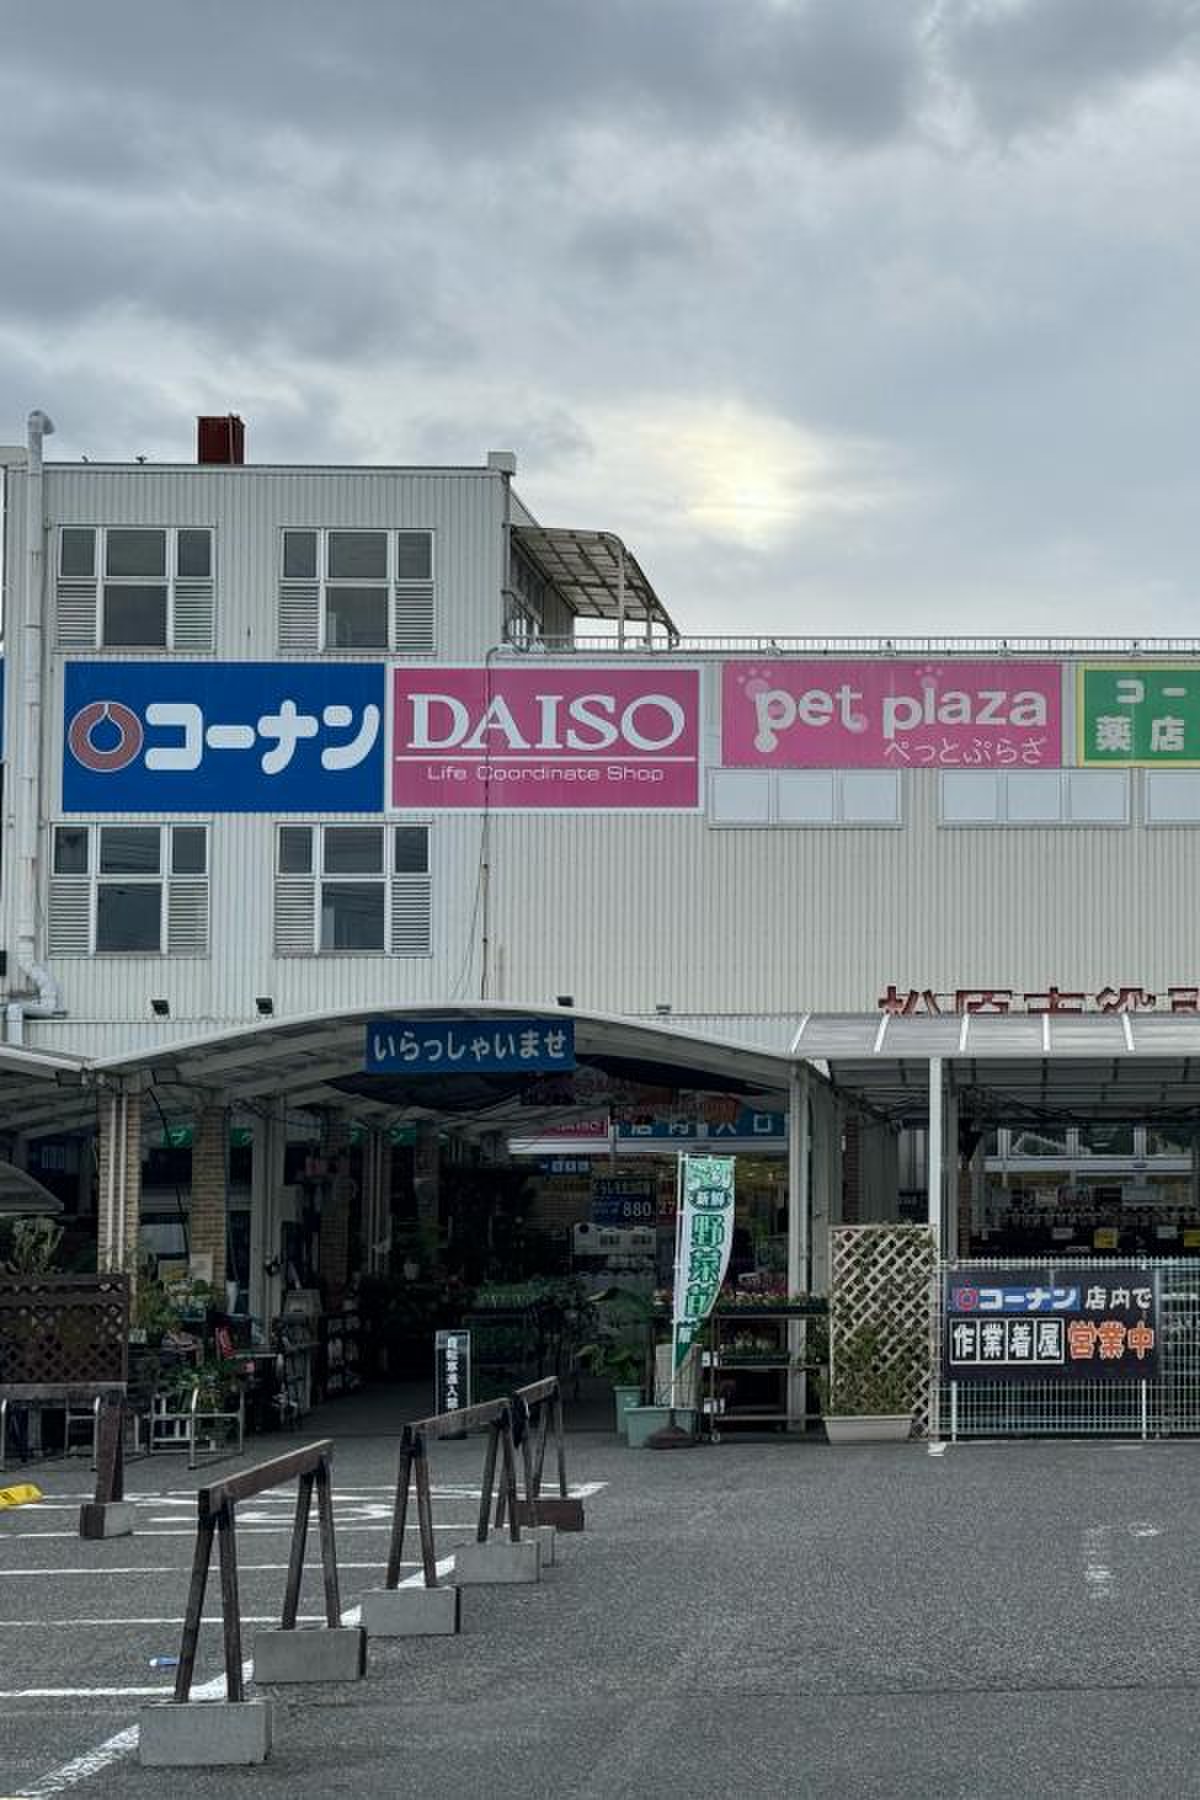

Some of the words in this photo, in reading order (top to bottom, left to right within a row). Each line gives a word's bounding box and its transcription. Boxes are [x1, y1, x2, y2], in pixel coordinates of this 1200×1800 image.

[146, 699, 379, 774] コーナン
[406, 692, 685, 751] DAISO
[754, 685, 868, 753] pet
[882, 684, 1047, 738] plaza
[1096, 716, 1184, 750] 薬店
[427, 764, 467, 782] Life
[478, 764, 601, 782] Coordinate
[609, 764, 665, 785] Shop
[374, 1029, 567, 1062] いらっしゃいませ
[979, 1285, 1077, 1311] コーナン
[1085, 1285, 1154, 1311] 店内で
[953, 1323, 1061, 1360] 作業着屋
[1067, 1320, 1155, 1360] 営業中
